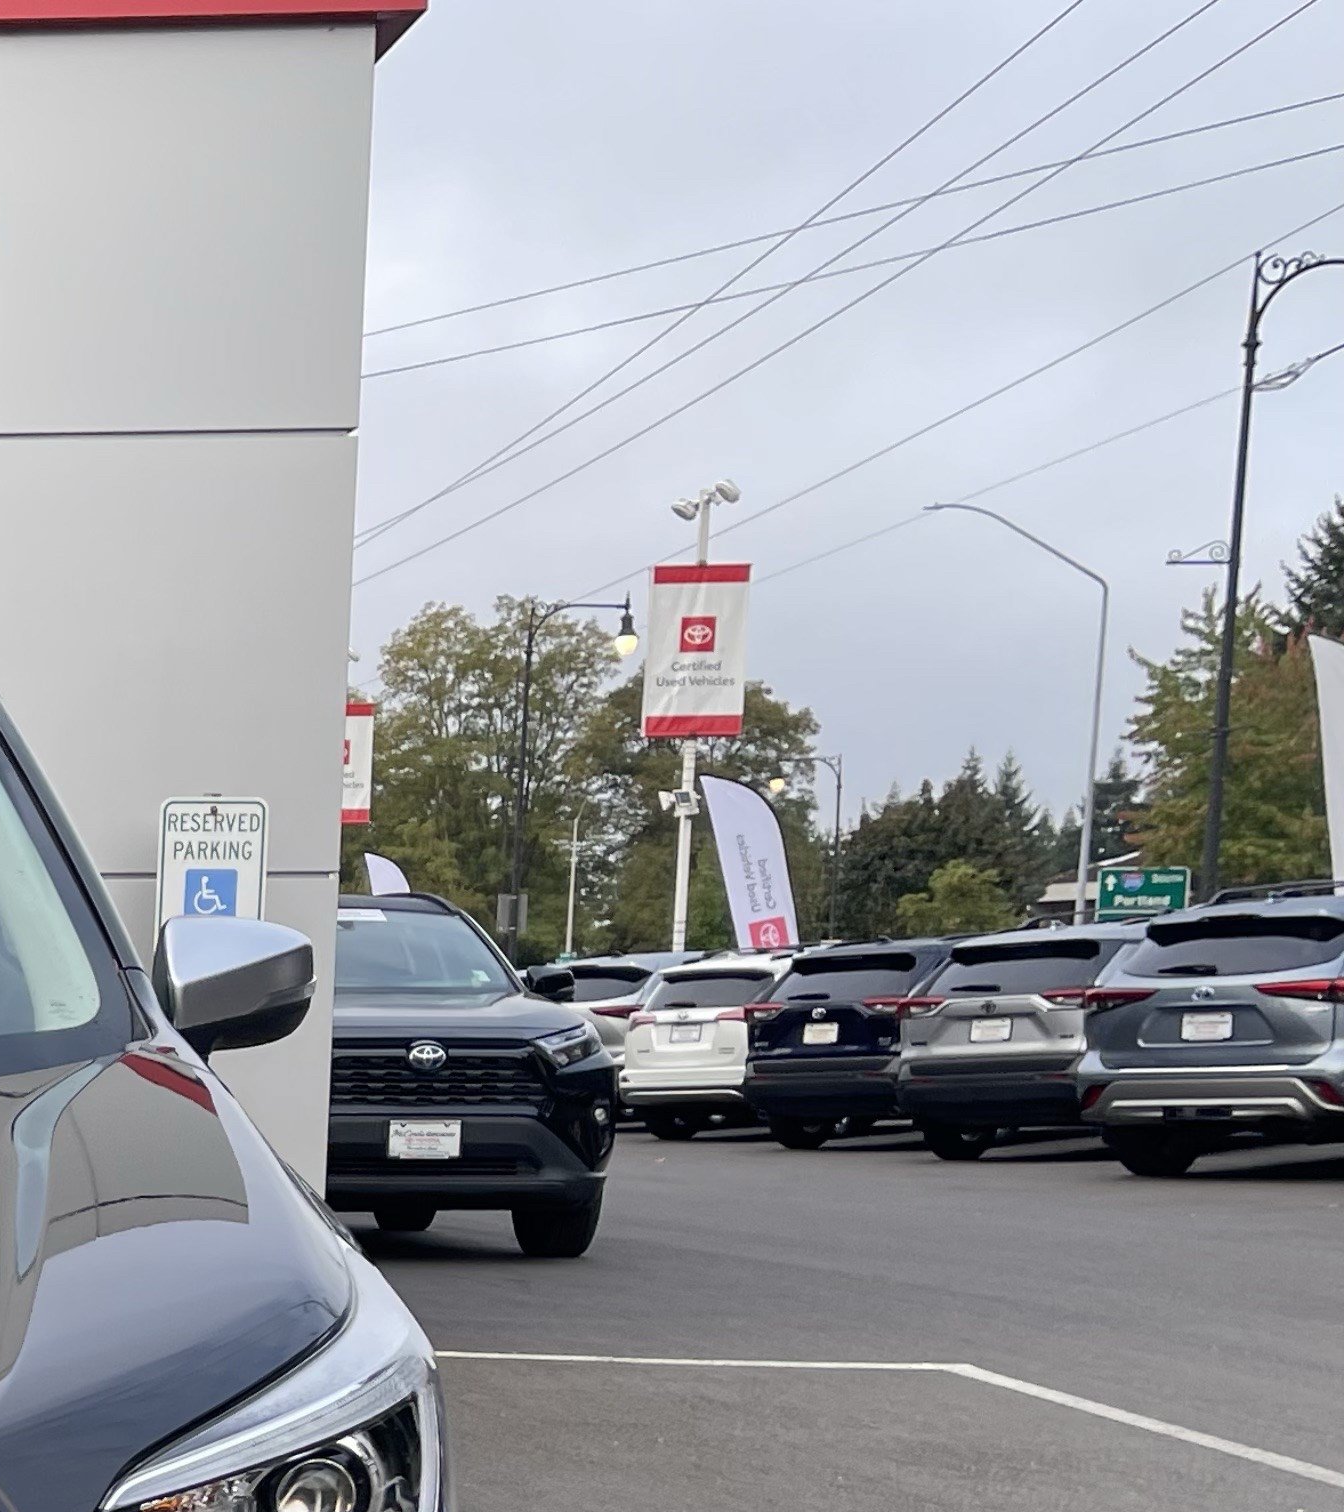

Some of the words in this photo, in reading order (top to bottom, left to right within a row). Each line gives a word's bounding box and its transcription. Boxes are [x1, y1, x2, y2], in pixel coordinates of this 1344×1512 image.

[670, 660, 723, 672] Certified
[655, 675, 687, 687] Used
[688, 675, 736, 687] Vehicles
[167, 812, 261, 833] RESERVED
[173, 840, 253, 861] PARKING
